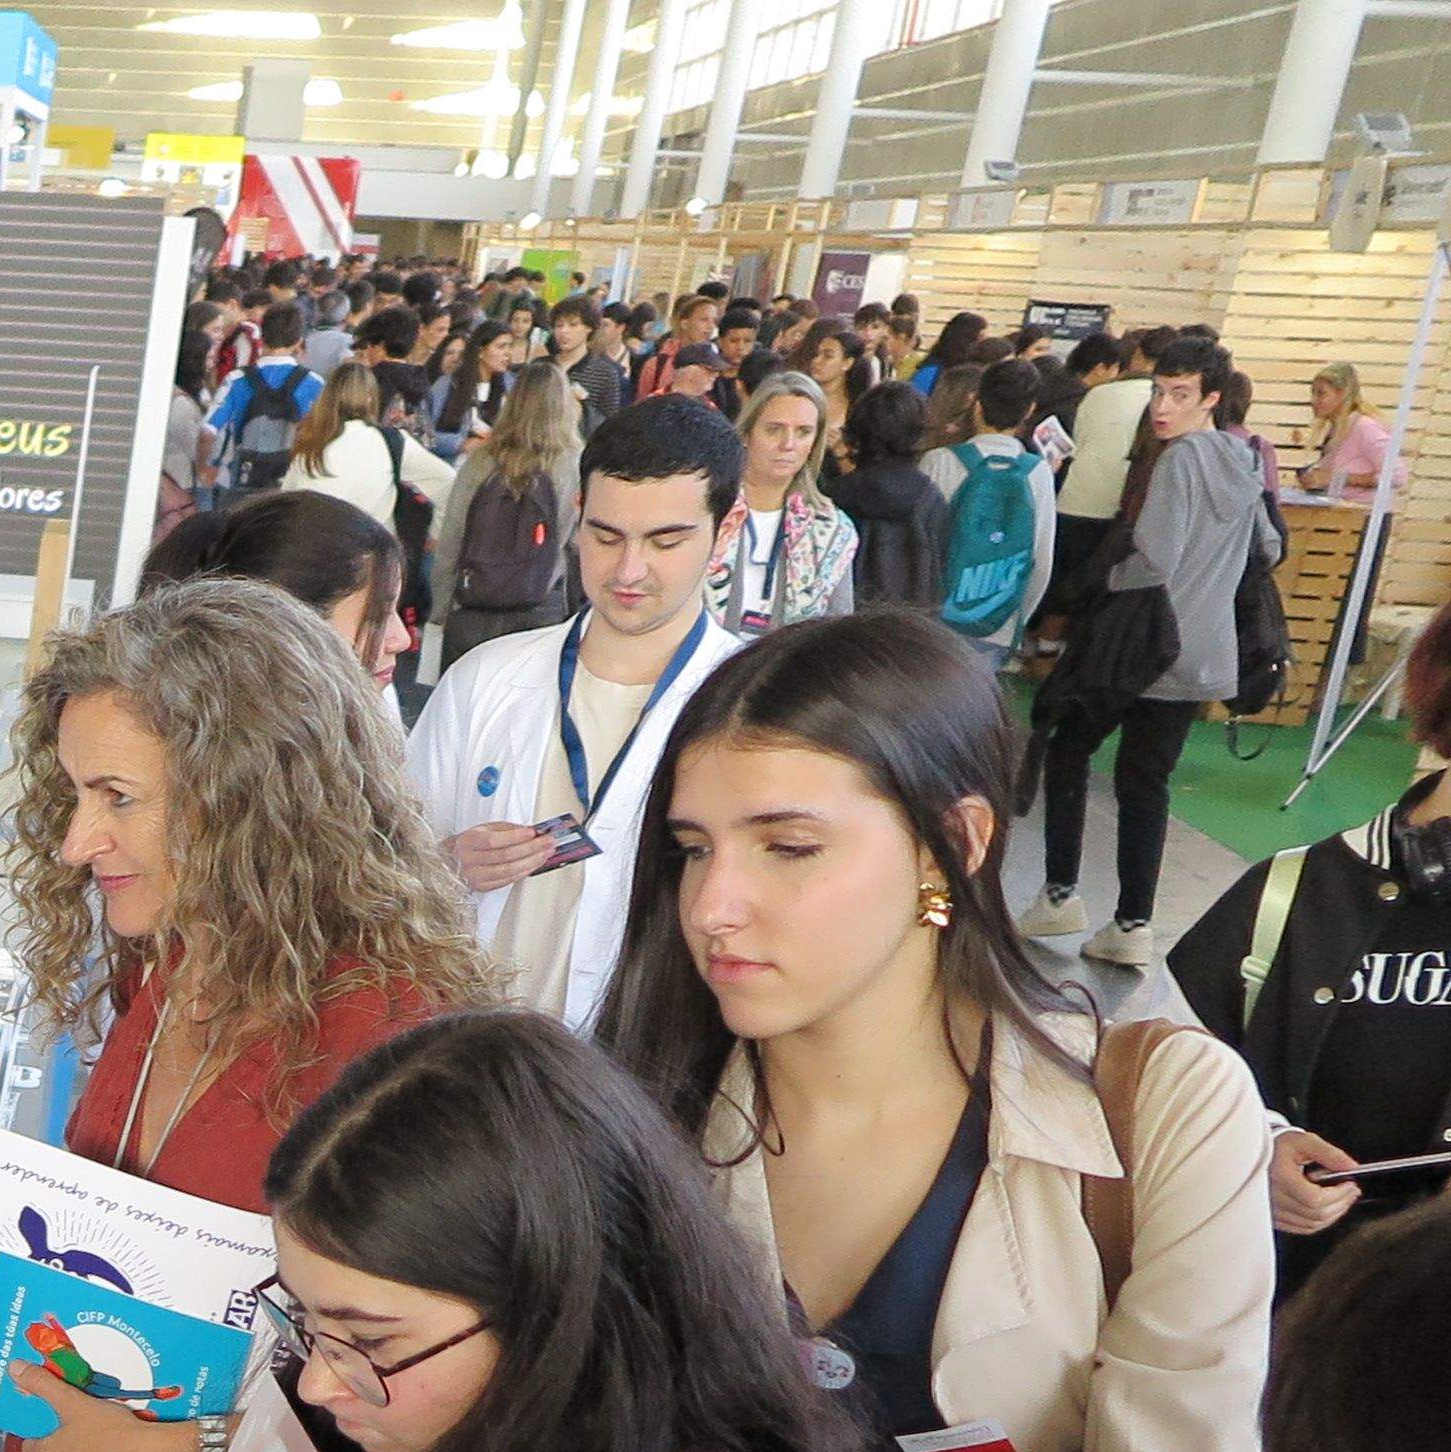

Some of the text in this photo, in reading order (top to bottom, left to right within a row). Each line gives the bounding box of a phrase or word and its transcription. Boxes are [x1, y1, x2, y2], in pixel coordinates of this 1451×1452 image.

[1339, 951, 1451, 1005] SUG
[0, 1161, 89, 1199] aprender
[94, 1196, 119, 1214] de
[126, 1205, 189, 1238] deixes
[9, 1284, 27, 1314] ideas
[76, 1310, 161, 1368] CIFP Montecelo
